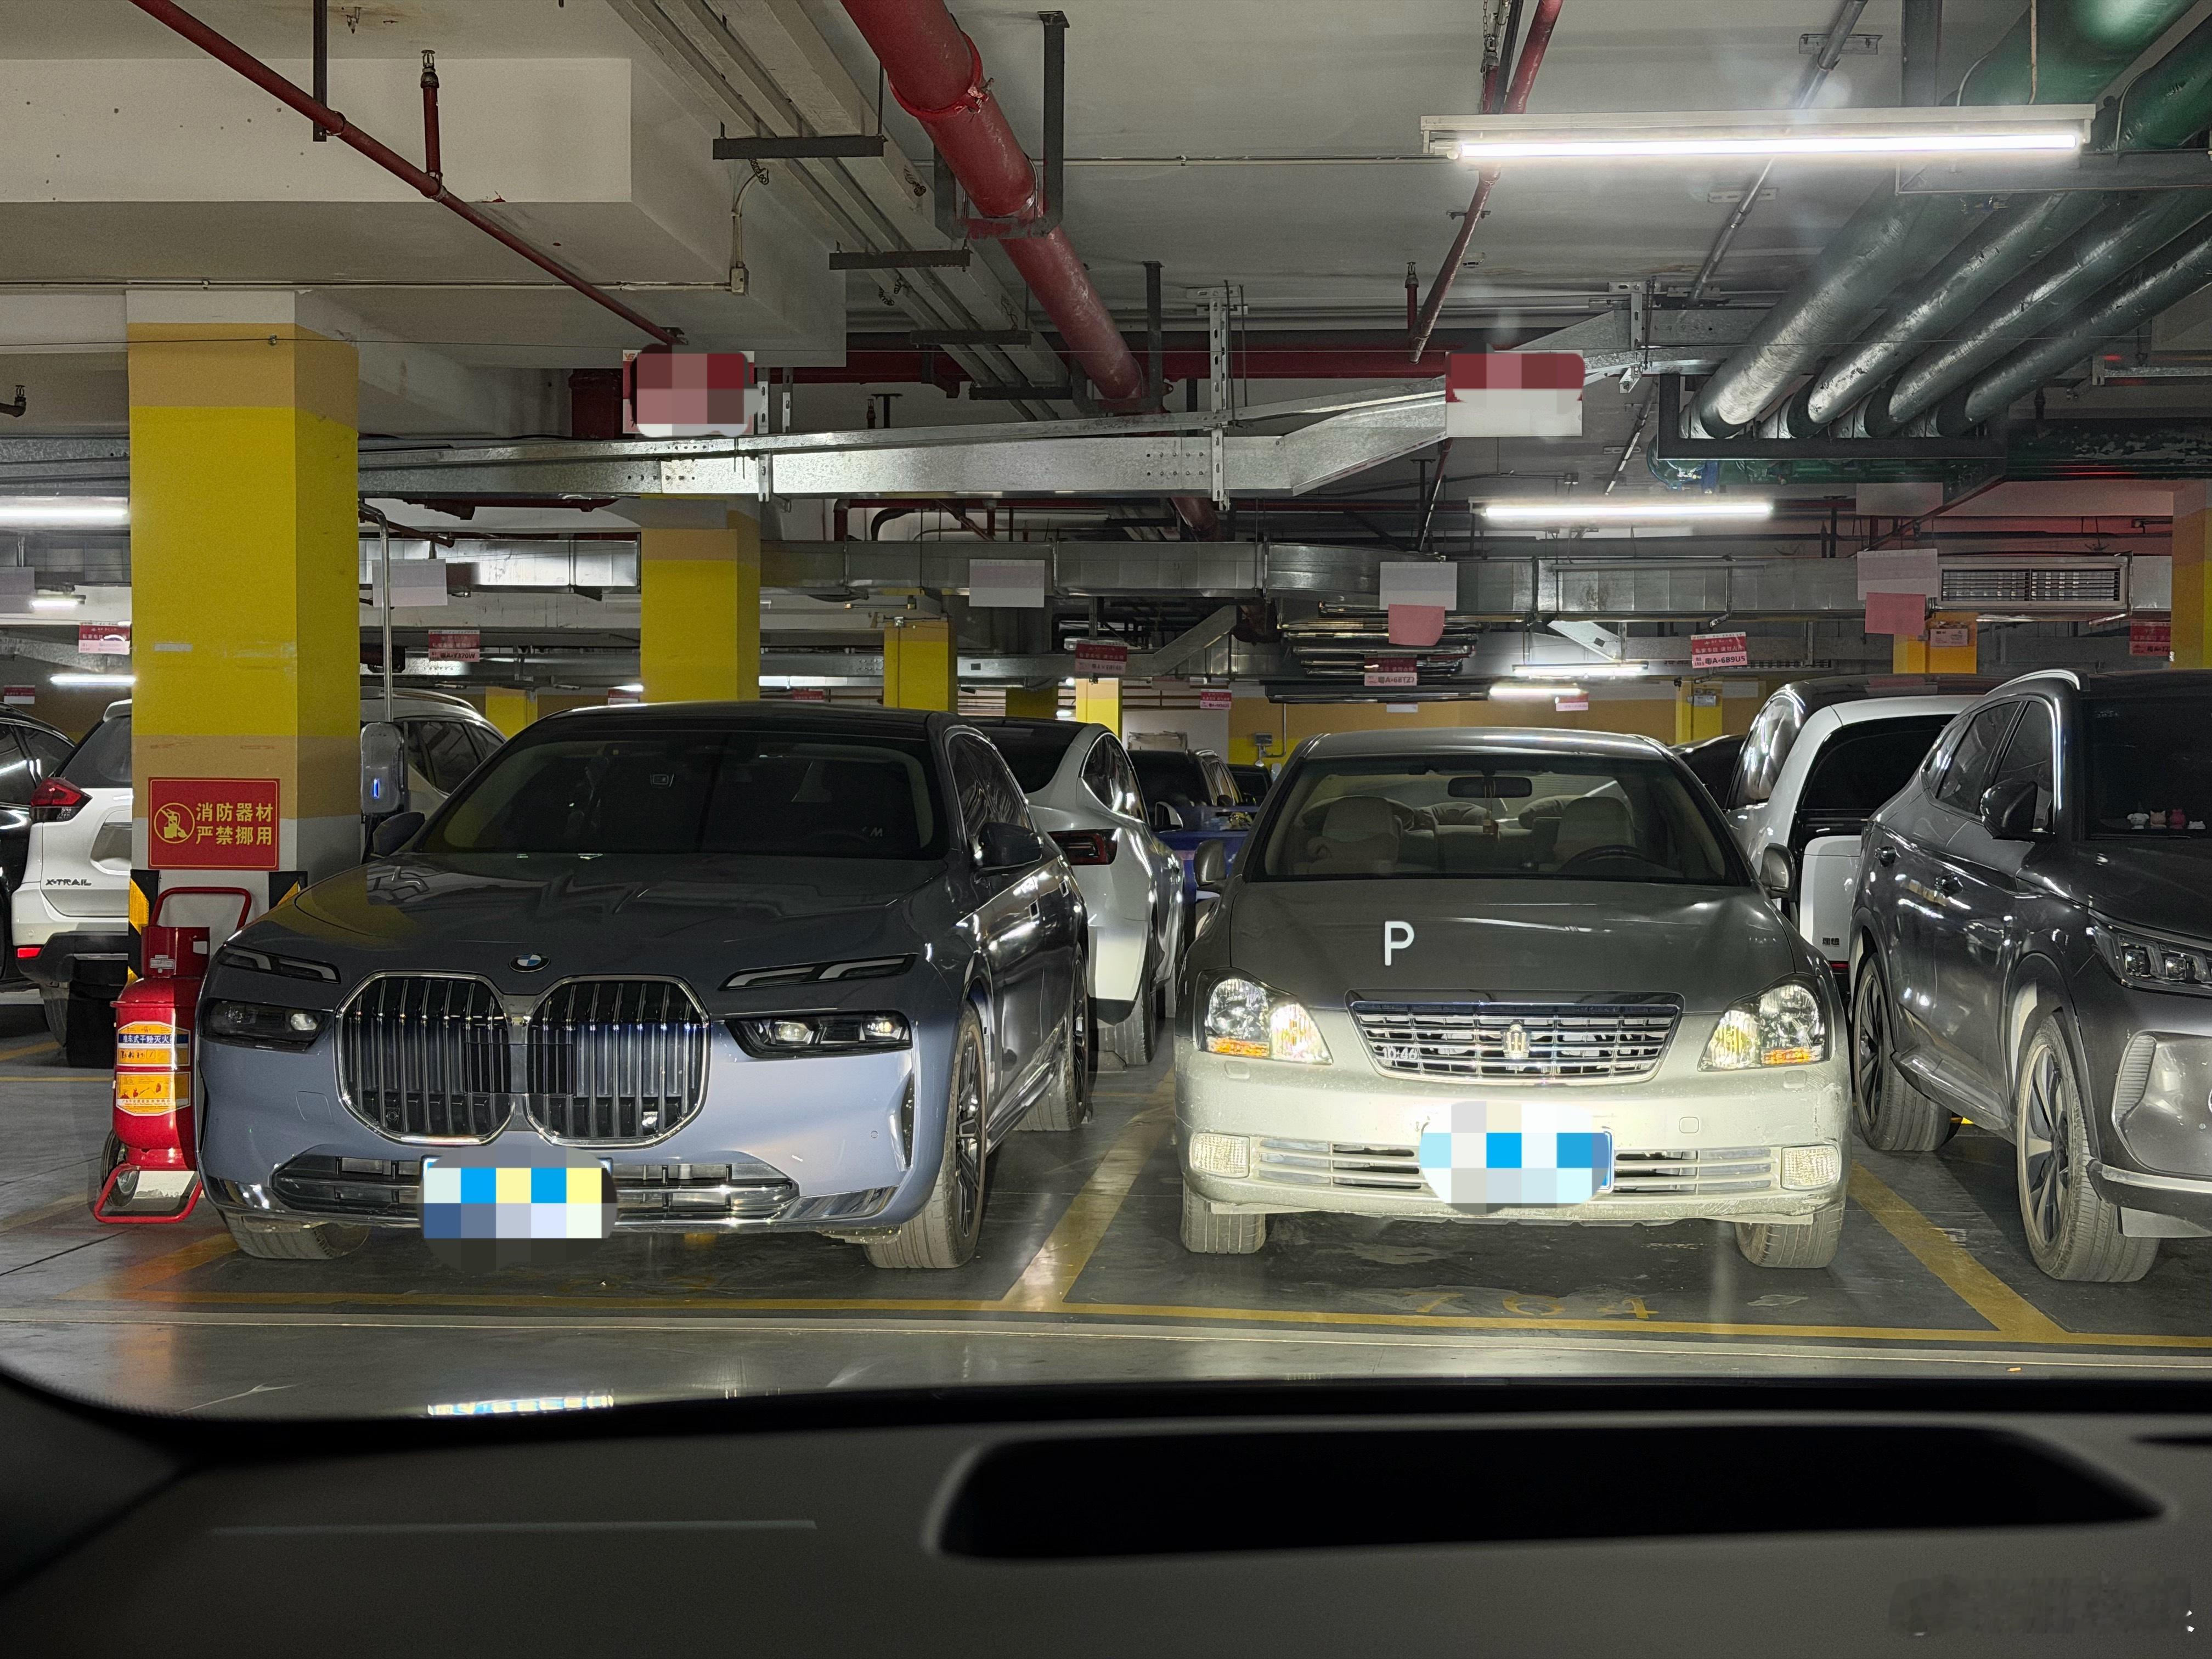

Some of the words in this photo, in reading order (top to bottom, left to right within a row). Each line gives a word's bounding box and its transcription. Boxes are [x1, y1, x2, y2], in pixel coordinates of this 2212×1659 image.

[196, 802, 273, 822] 消防器材
[196, 826, 272, 845] 严禁挪用
[1385, 921, 1414, 966] P
[1383, 1047, 1418, 1059] 10:46
